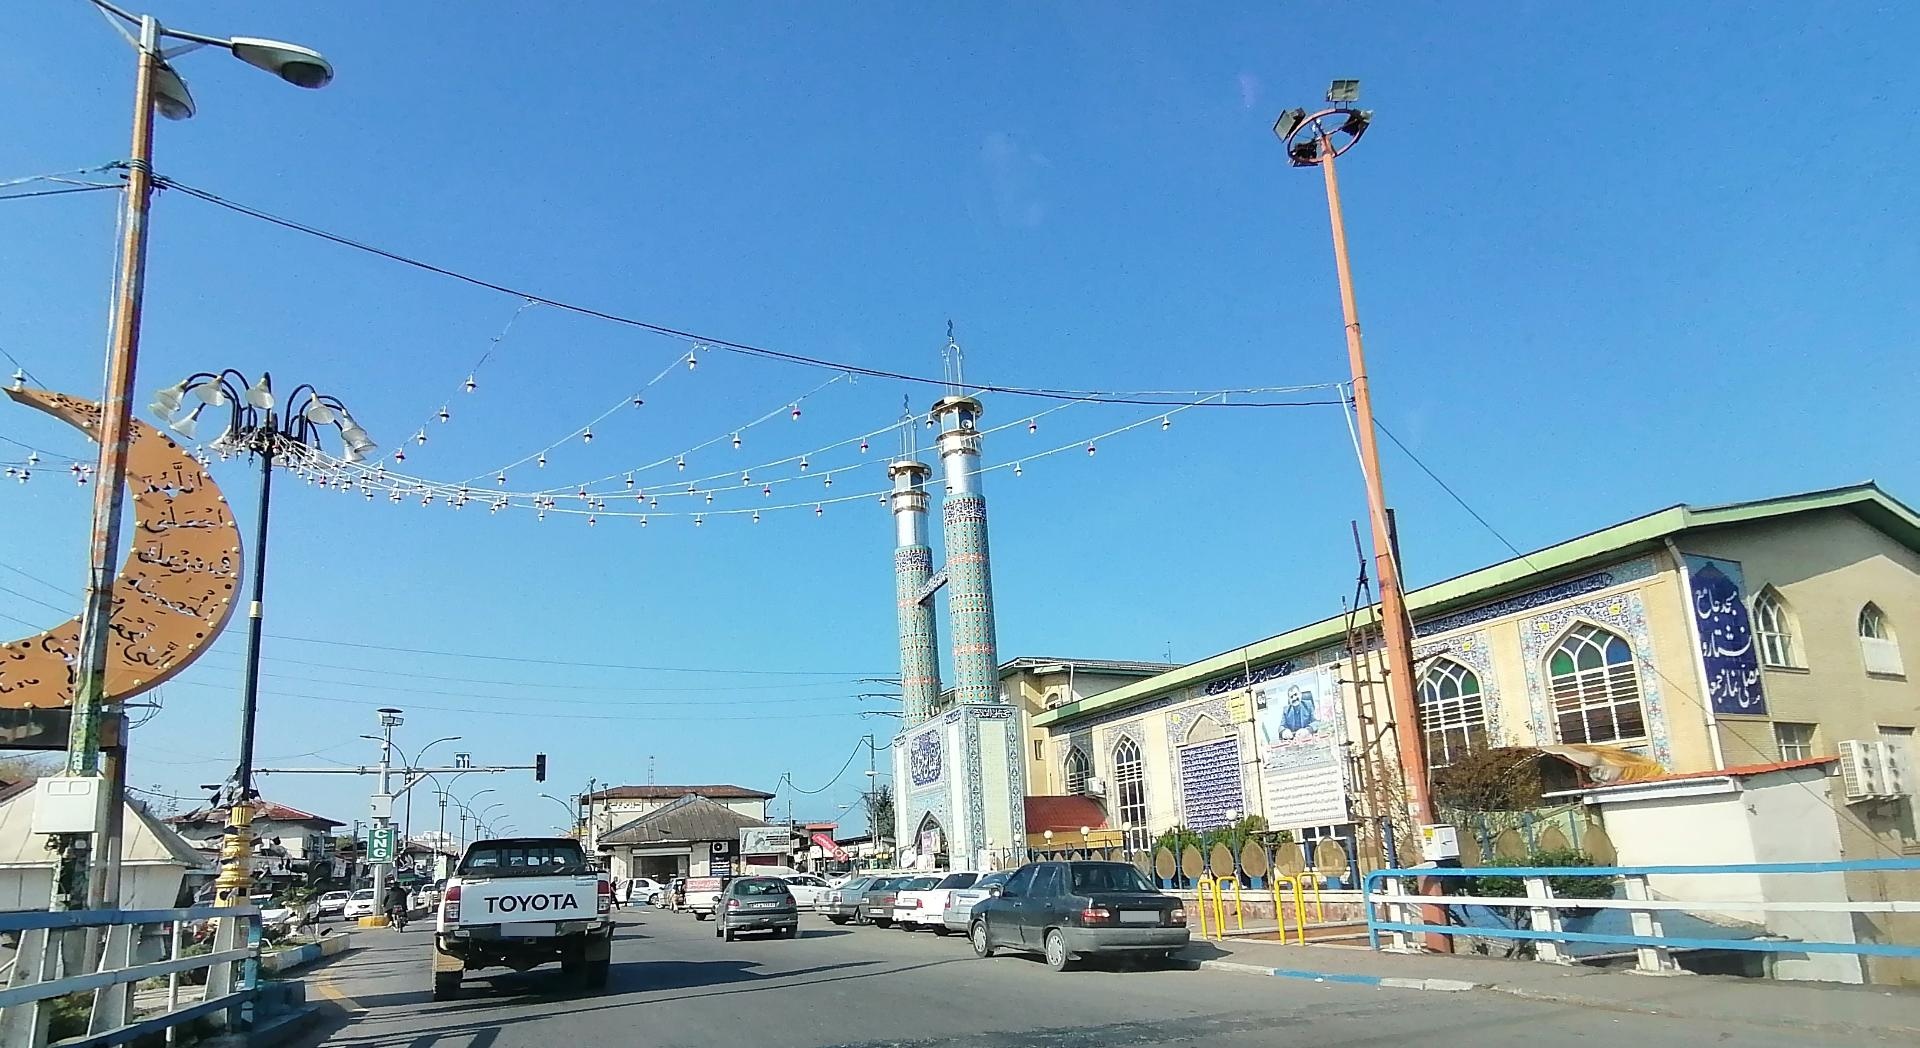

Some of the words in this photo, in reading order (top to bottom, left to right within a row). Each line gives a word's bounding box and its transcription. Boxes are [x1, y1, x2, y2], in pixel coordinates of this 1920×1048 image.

[1695, 588, 1720, 622] جامع
[1720, 591, 1737, 616] مسجد
[373, 829, 388, 858] CNG
[484, 893, 578, 914] TOYOTA
